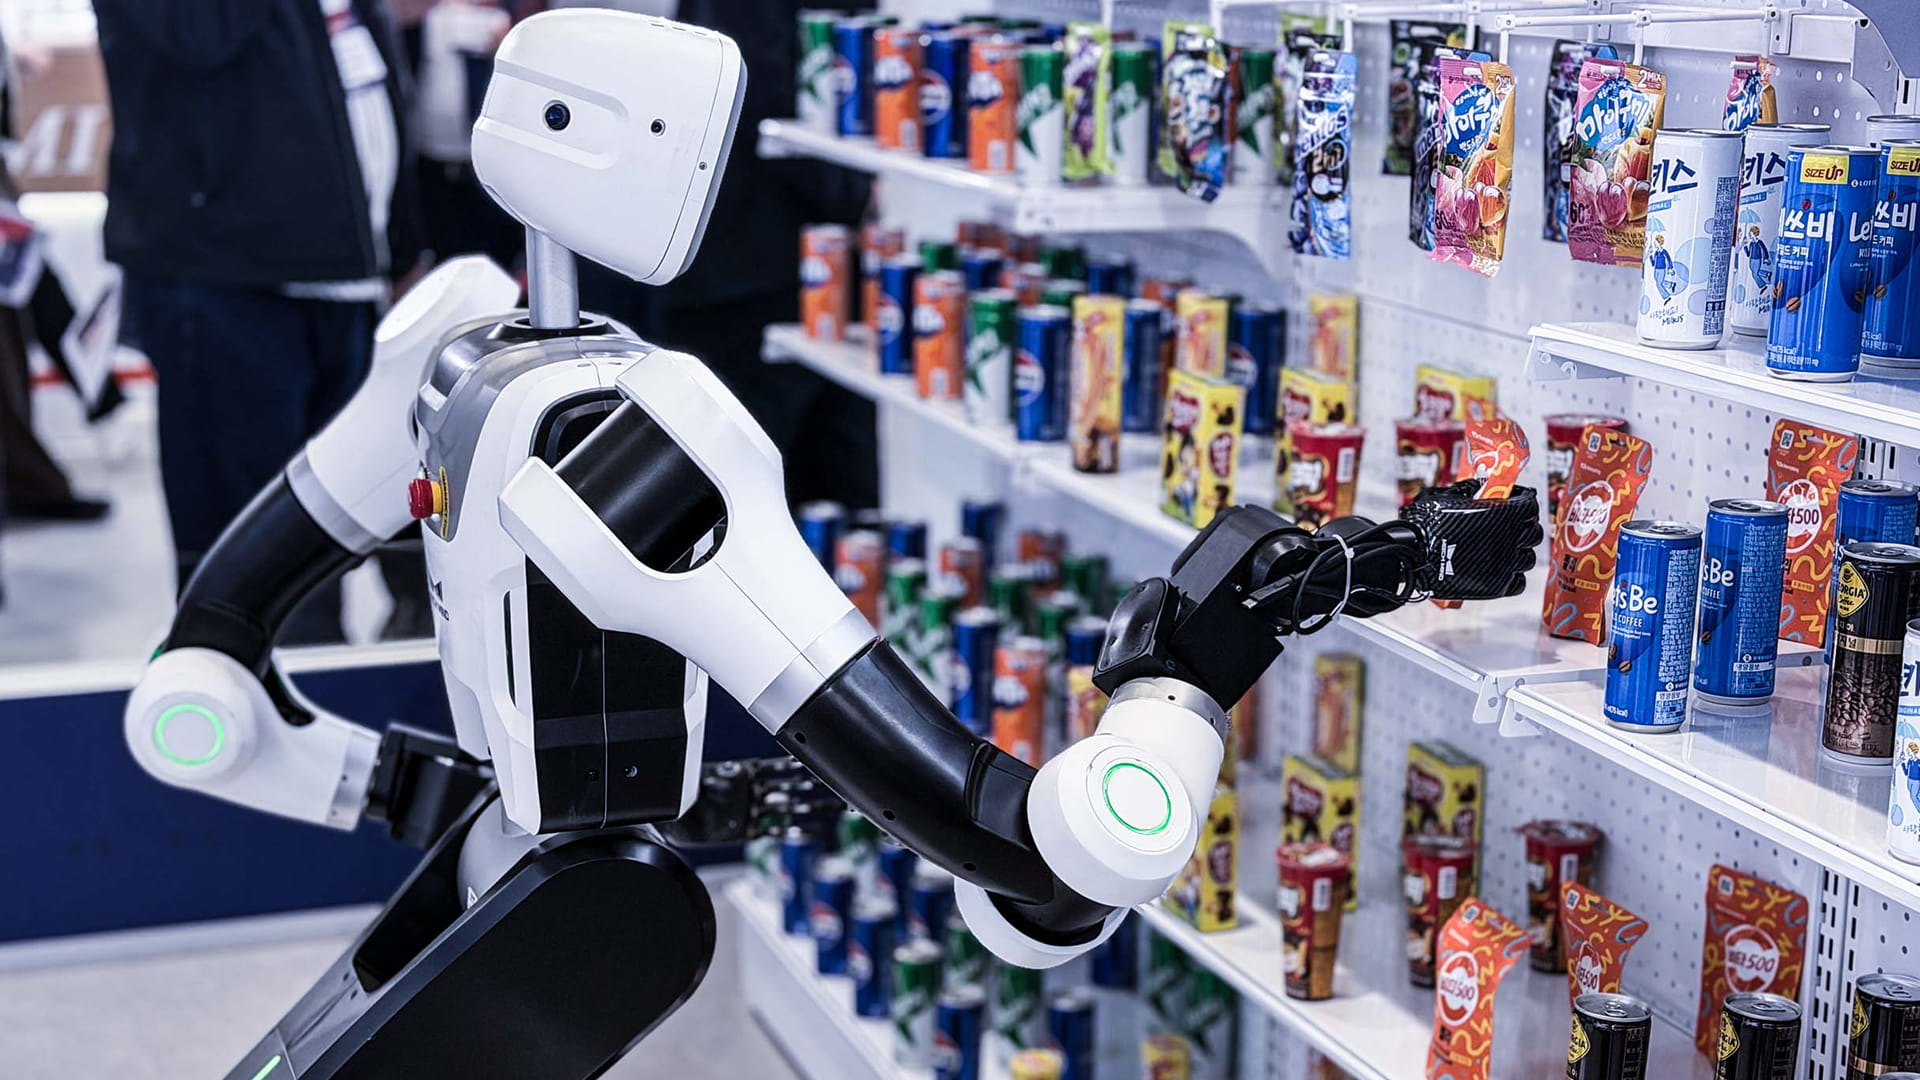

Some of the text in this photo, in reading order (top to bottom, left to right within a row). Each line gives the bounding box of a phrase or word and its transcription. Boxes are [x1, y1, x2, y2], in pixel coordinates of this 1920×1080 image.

[1649, 158, 1698, 196] 키스
[1742, 152, 1785, 188] 키스
[1804, 165, 1844, 181] SIZE UP
[1890, 160, 1908, 170] SIZE
[1779, 207, 1836, 242] 쓰비
[1617, 614, 1643, 628] COFFEE
